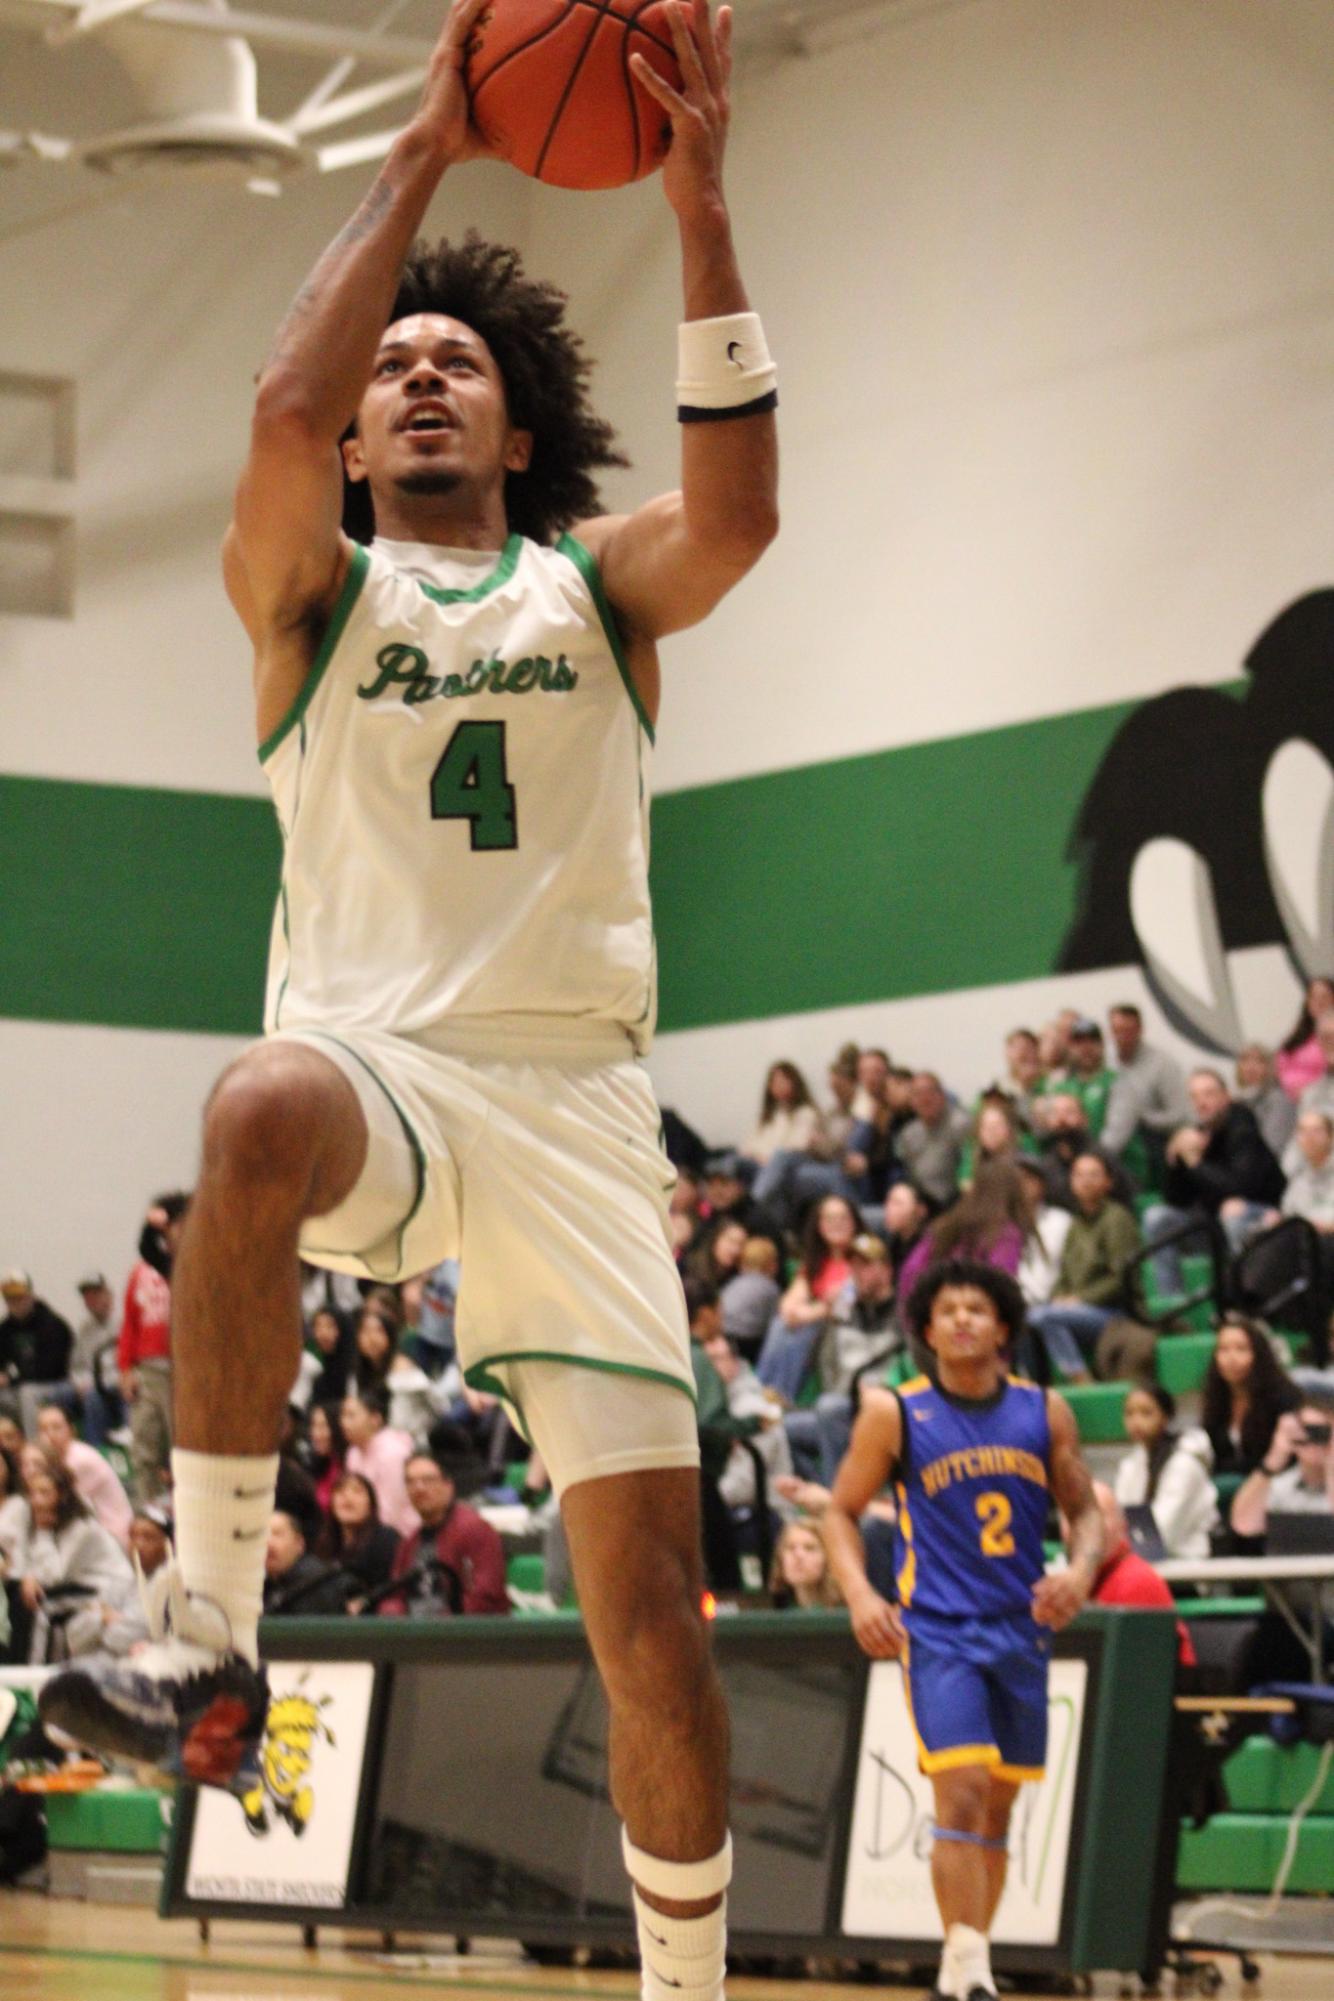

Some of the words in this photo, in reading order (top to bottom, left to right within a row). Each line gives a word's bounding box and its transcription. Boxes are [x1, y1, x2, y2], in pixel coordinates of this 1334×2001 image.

[357, 643, 578, 705] Panthers
[430, 720, 518, 852] 4
[975, 1491, 1015, 1557] 2
